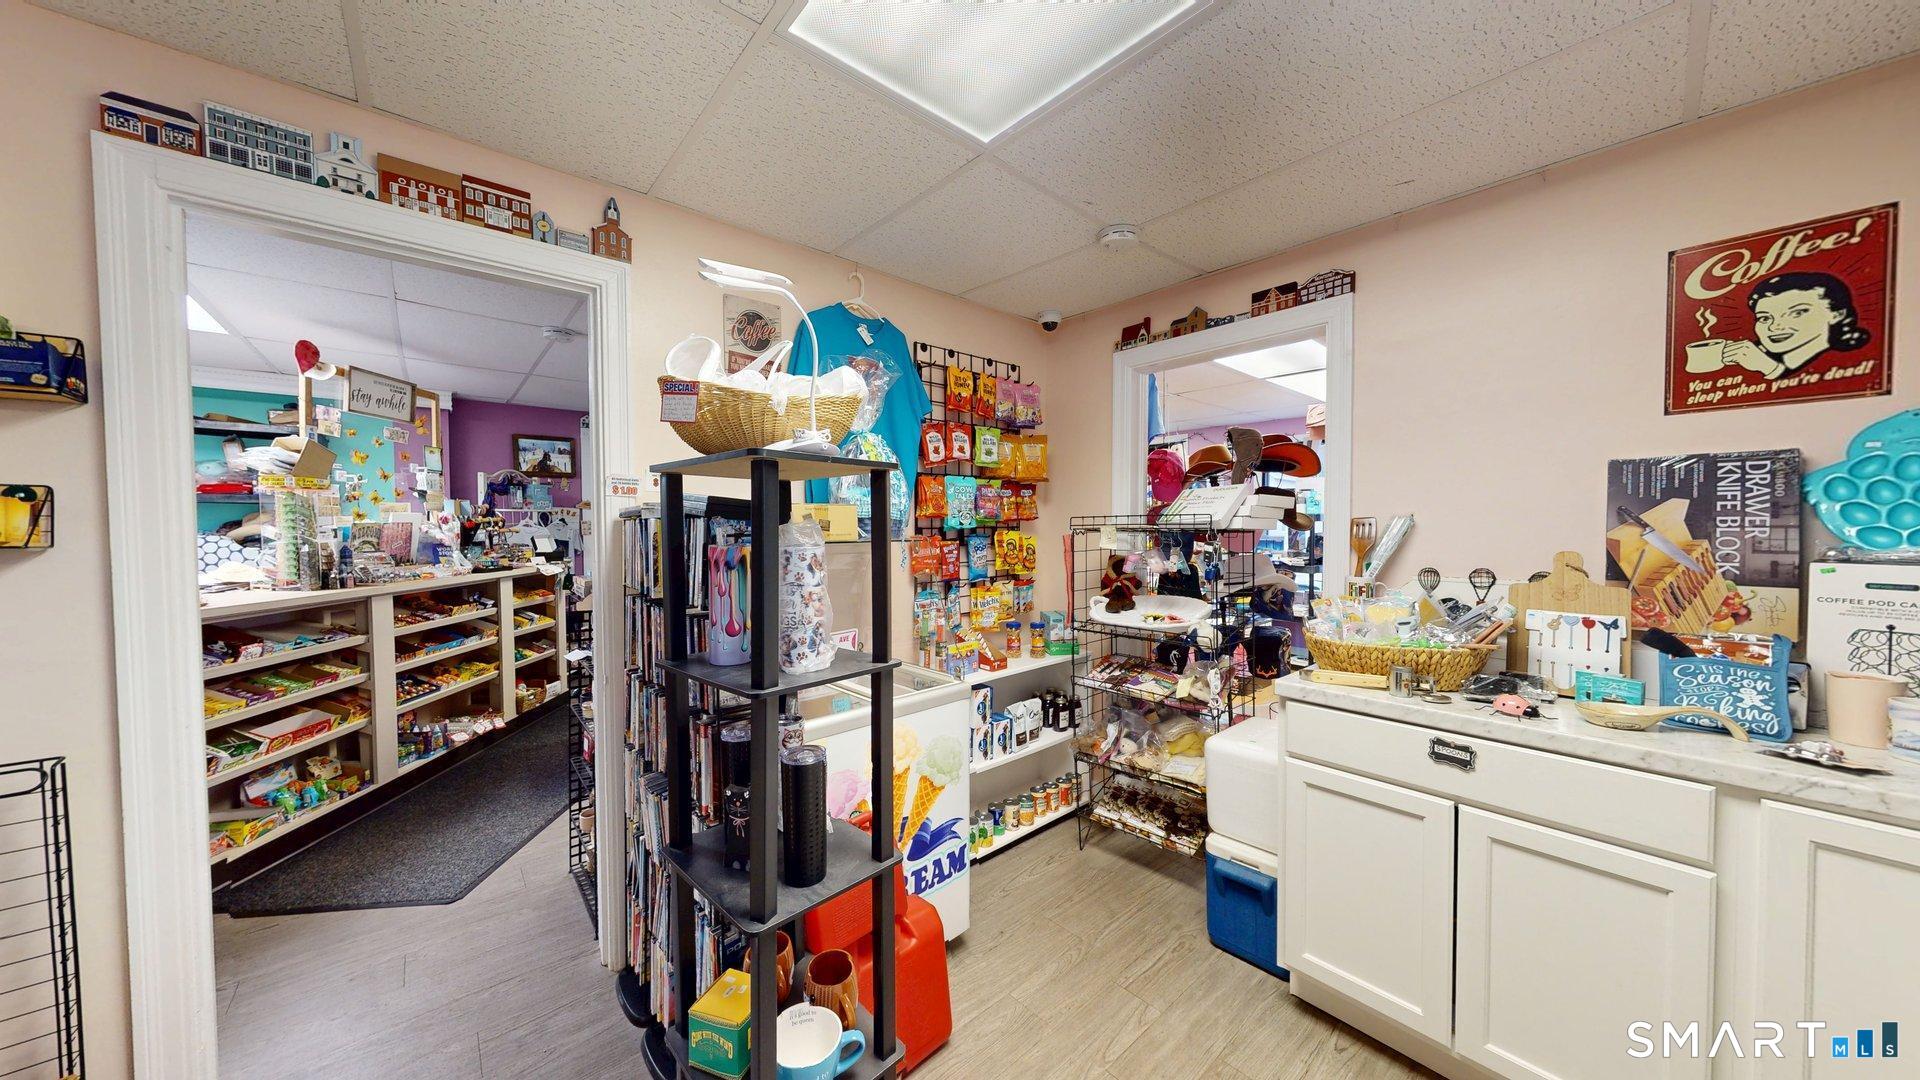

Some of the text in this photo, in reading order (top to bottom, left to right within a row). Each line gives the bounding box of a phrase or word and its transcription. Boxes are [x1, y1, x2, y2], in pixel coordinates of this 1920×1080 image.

[1684, 216, 1873, 300] Coffee!
[731, 316, 777, 347] Coffee
[1686, 361, 1873, 405] sleep when you're dead!
[1687, 374, 1743, 393] You can
[351, 387, 373, 408] stay
[375, 393, 407, 414] awhile
[1744, 460, 1772, 539] DRAWER
[1715, 462, 1742, 575] KNIFE BLOCK
[1817, 596, 1864, 605] COFFEE
[1868, 600, 1896, 608] POD
[1673, 664, 1776, 692] Season
[1436, 745, 1468, 759] SPOONS
